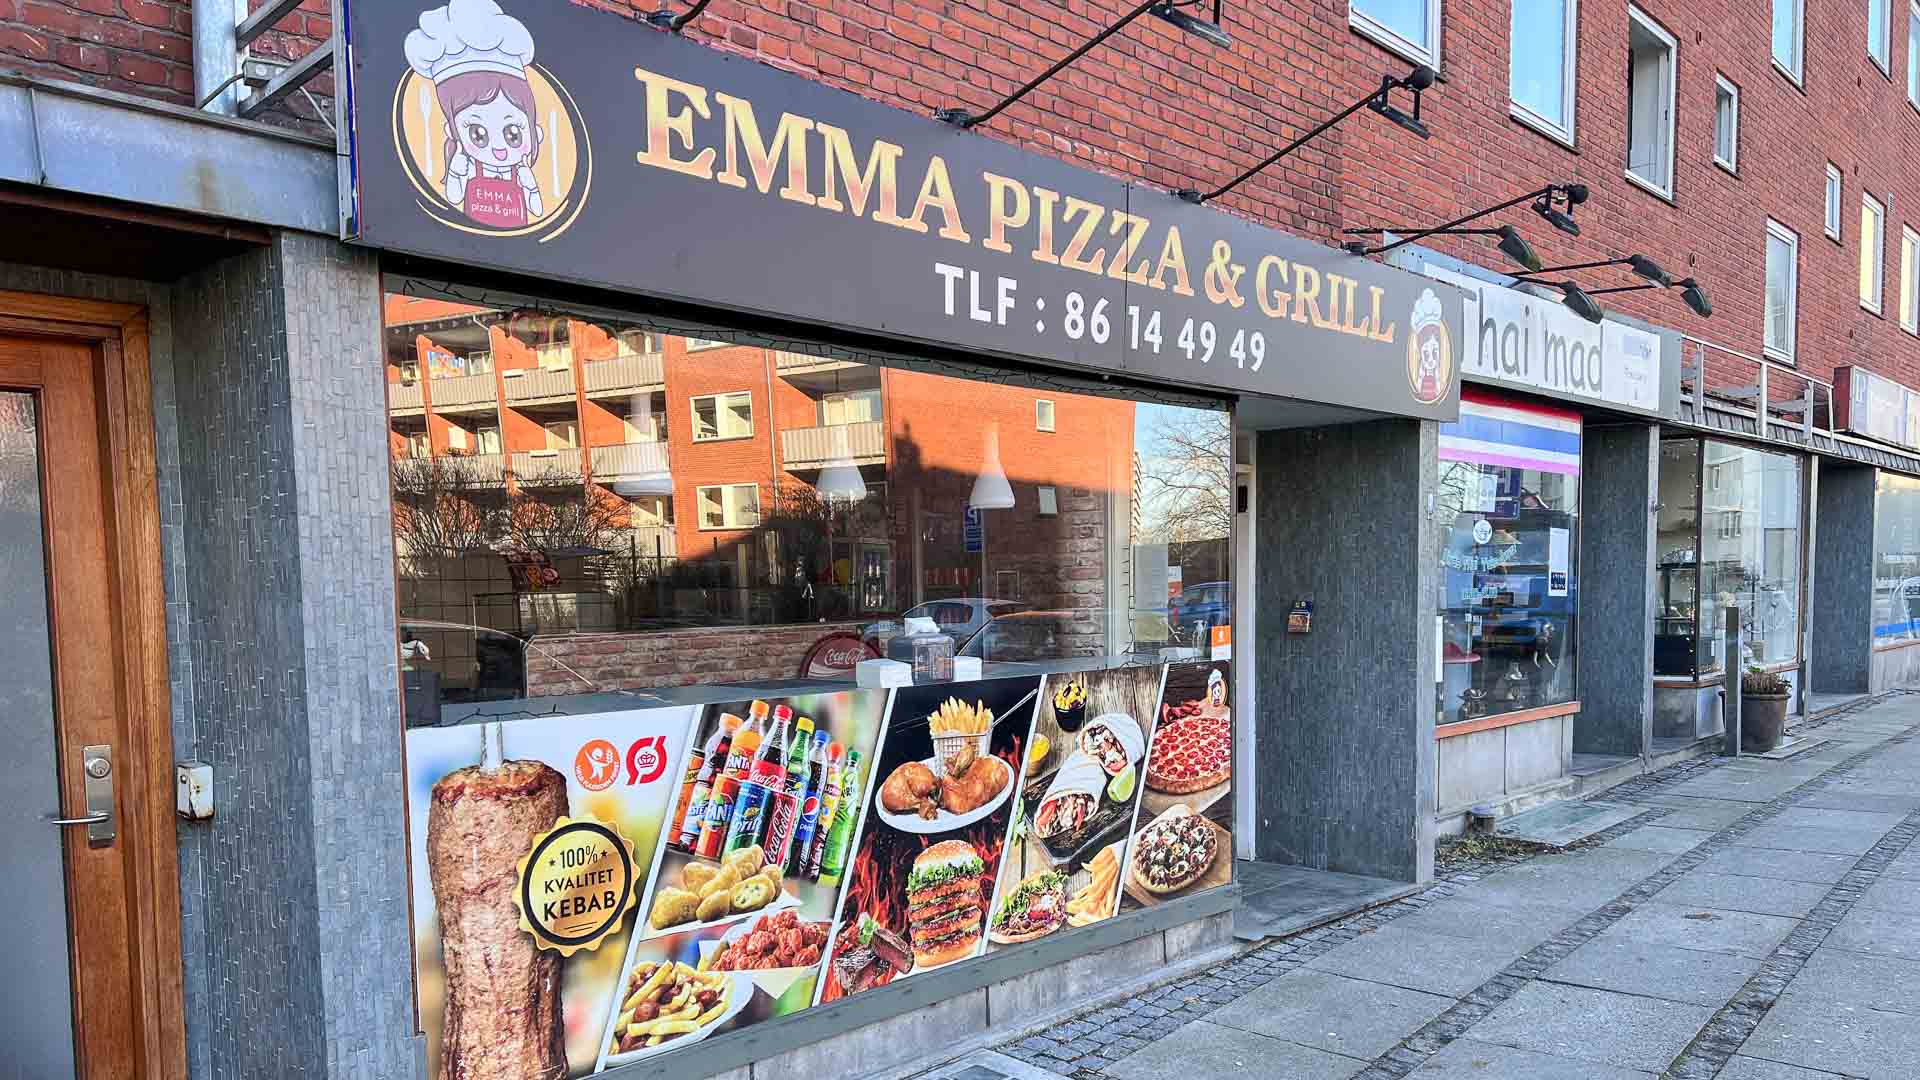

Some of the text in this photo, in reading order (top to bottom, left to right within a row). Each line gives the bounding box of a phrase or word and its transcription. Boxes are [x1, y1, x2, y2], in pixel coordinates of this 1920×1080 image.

[476, 188, 513, 202] EMMA
[634, 66, 1396, 343] EMMA PIZZA & GRILL
[471, 203, 520, 217] pizza & grill
[934, 262, 1017, 325] TLF
[1064, 291, 1111, 344] 86
[1128, 305, 1162, 354] 14
[1178, 318, 1217, 363] 49
[1230, 328, 1266, 373] 49
[560, 843, 598, 869] 100%
[544, 868, 614, 894] KVALITET
[543, 890, 616, 921] KEBAB
